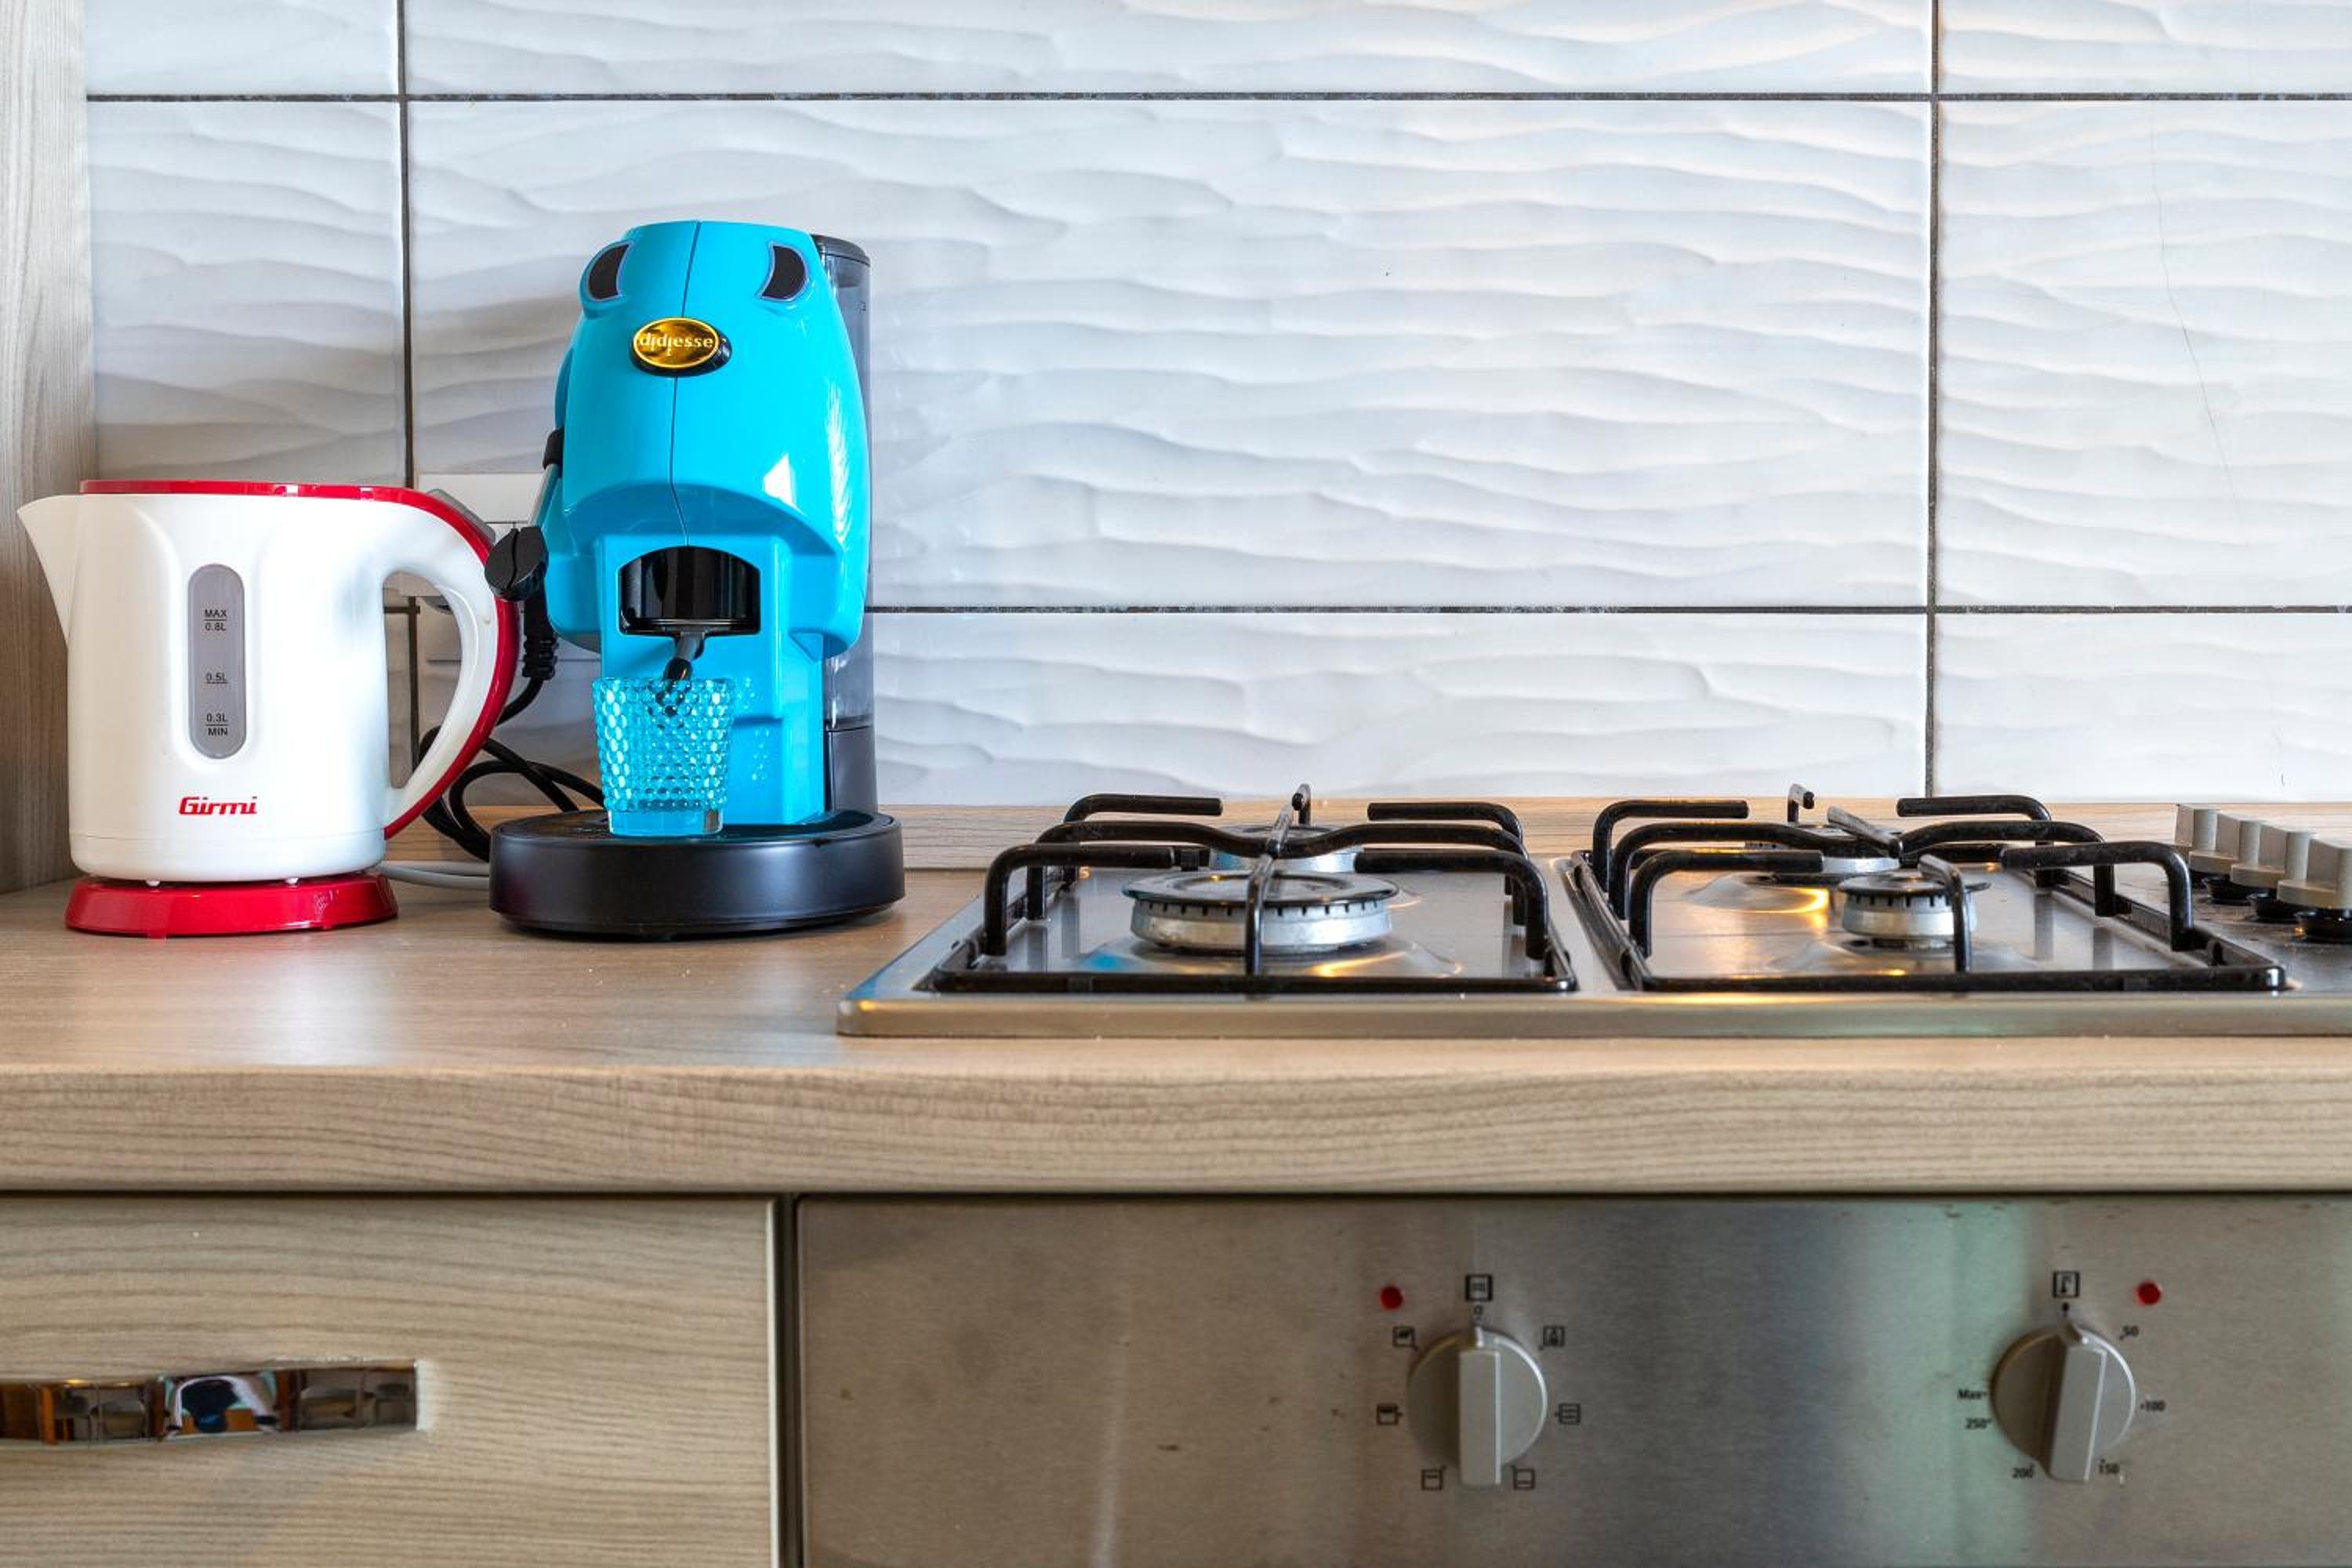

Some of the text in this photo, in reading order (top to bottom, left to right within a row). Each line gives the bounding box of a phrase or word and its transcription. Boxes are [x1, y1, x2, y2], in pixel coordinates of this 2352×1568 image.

[205, 609, 227, 618] MAX
[205, 622, 227, 631] 0.8L
[205, 673, 227, 681] 0.5L
[206, 713, 227, 722] 0.3L
[208, 728, 228, 736] MIN
[179, 796, 258, 815] Girmi
